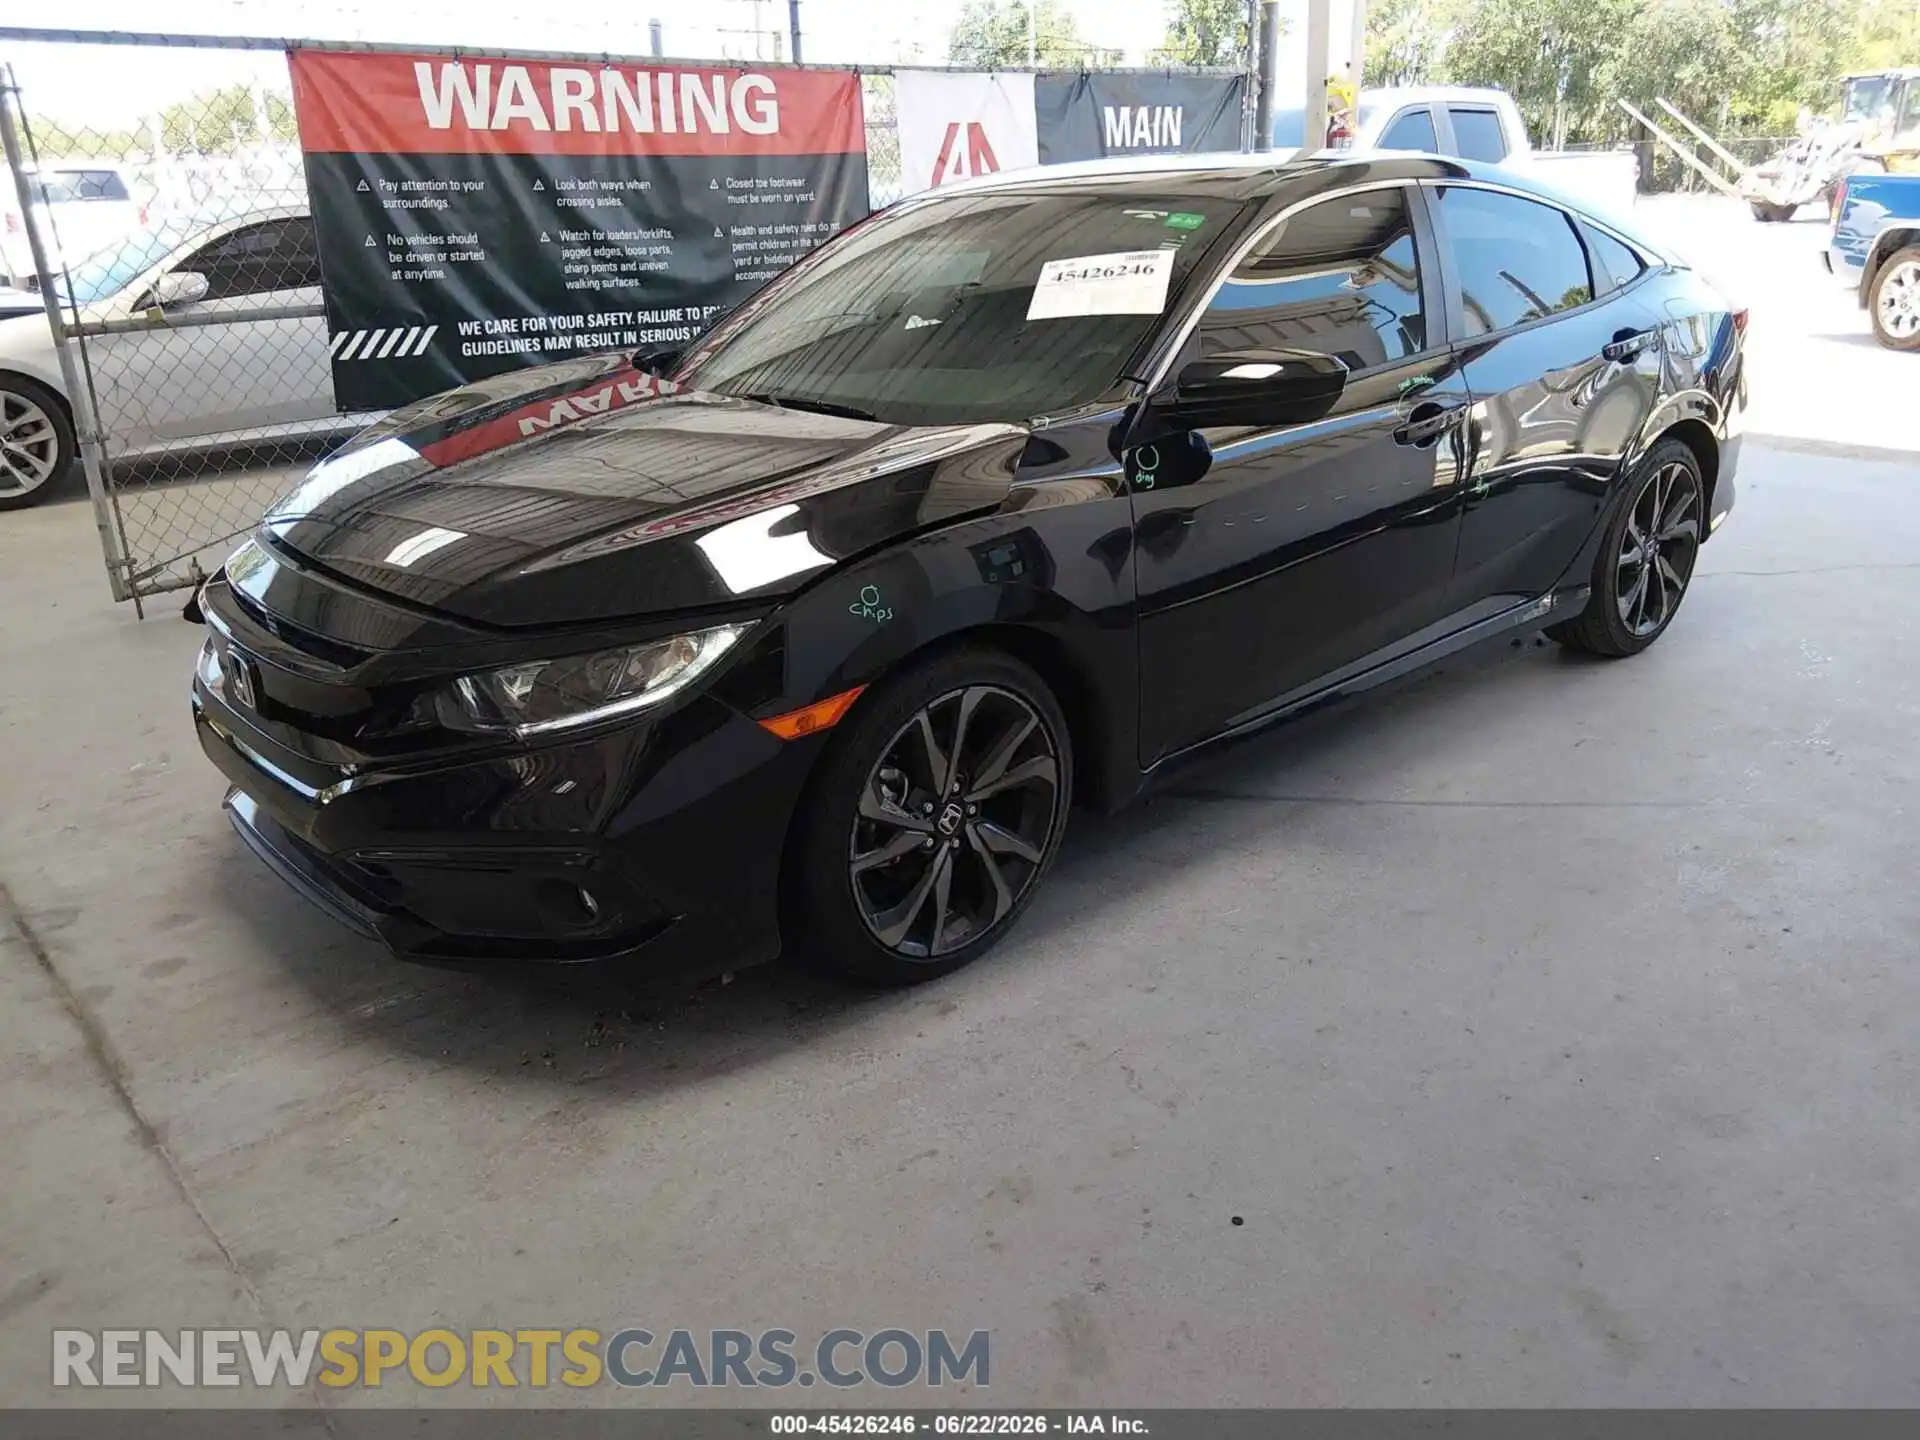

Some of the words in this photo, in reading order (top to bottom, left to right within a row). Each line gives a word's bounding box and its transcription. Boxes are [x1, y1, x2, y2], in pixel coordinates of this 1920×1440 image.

[413, 62, 780, 135] WARNING
[1104, 106, 1183, 148] MAIN
[379, 179, 398, 193] Pay
[402, 180, 448, 191] attention
[450, 179, 460, 191] to
[463, 181, 484, 193] your
[555, 179, 576, 190] Look
[578, 179, 598, 191] both
[600, 180, 624, 192] ways
[626, 178, 650, 190] when
[726, 177, 753, 189] Closed
[556, 196, 595, 208] crossing
[728, 194, 748, 204] must
[750, 193, 760, 203] be
[761, 194, 782, 203] worn
[784, 194, 793, 202] on
[560, 230, 590, 242] Watch
[593, 229, 605, 241] for
[730, 225, 757, 237] Health
[818, 221, 829, 232] do
[387, 234, 403, 246] No
[406, 234, 444, 245] vehicles
[447, 232, 478, 244] should
[759, 238, 790, 250] children
[389, 251, 402, 263] be
[406, 251, 435, 262] driven
[437, 252, 447, 261] or
[450, 249, 485, 261] started
[562, 246, 591, 260] jagged
[594, 245, 623, 258] edges,
[625, 244, 647, 256] loose
[564, 262, 589, 276] sharp
[591, 261, 618, 274] points
[620, 260, 637, 272] and
[639, 260, 669, 271] uneven
[733, 255, 752, 268] yard
[392, 268, 402, 280] at
[404, 268, 447, 281] anytime.
[1051, 264, 1155, 283] 45426246
[565, 278, 600, 291] walking
[458, 321, 482, 337] WE
[484, 318, 519, 334] CARE
[522, 316, 547, 333] FOR
[549, 314, 584, 331] YOUR
[587, 311, 635, 328] SAFETY.
[638, 308, 684, 325] FAILURE
[685, 306, 700, 320] TO
[462, 337, 540, 357] GUIDELINES
[544, 335, 572, 351] MAY
[576, 331, 621, 349] RESULT
[624, 329, 637, 344] IN
[640, 326, 690, 343] SERIOUS
